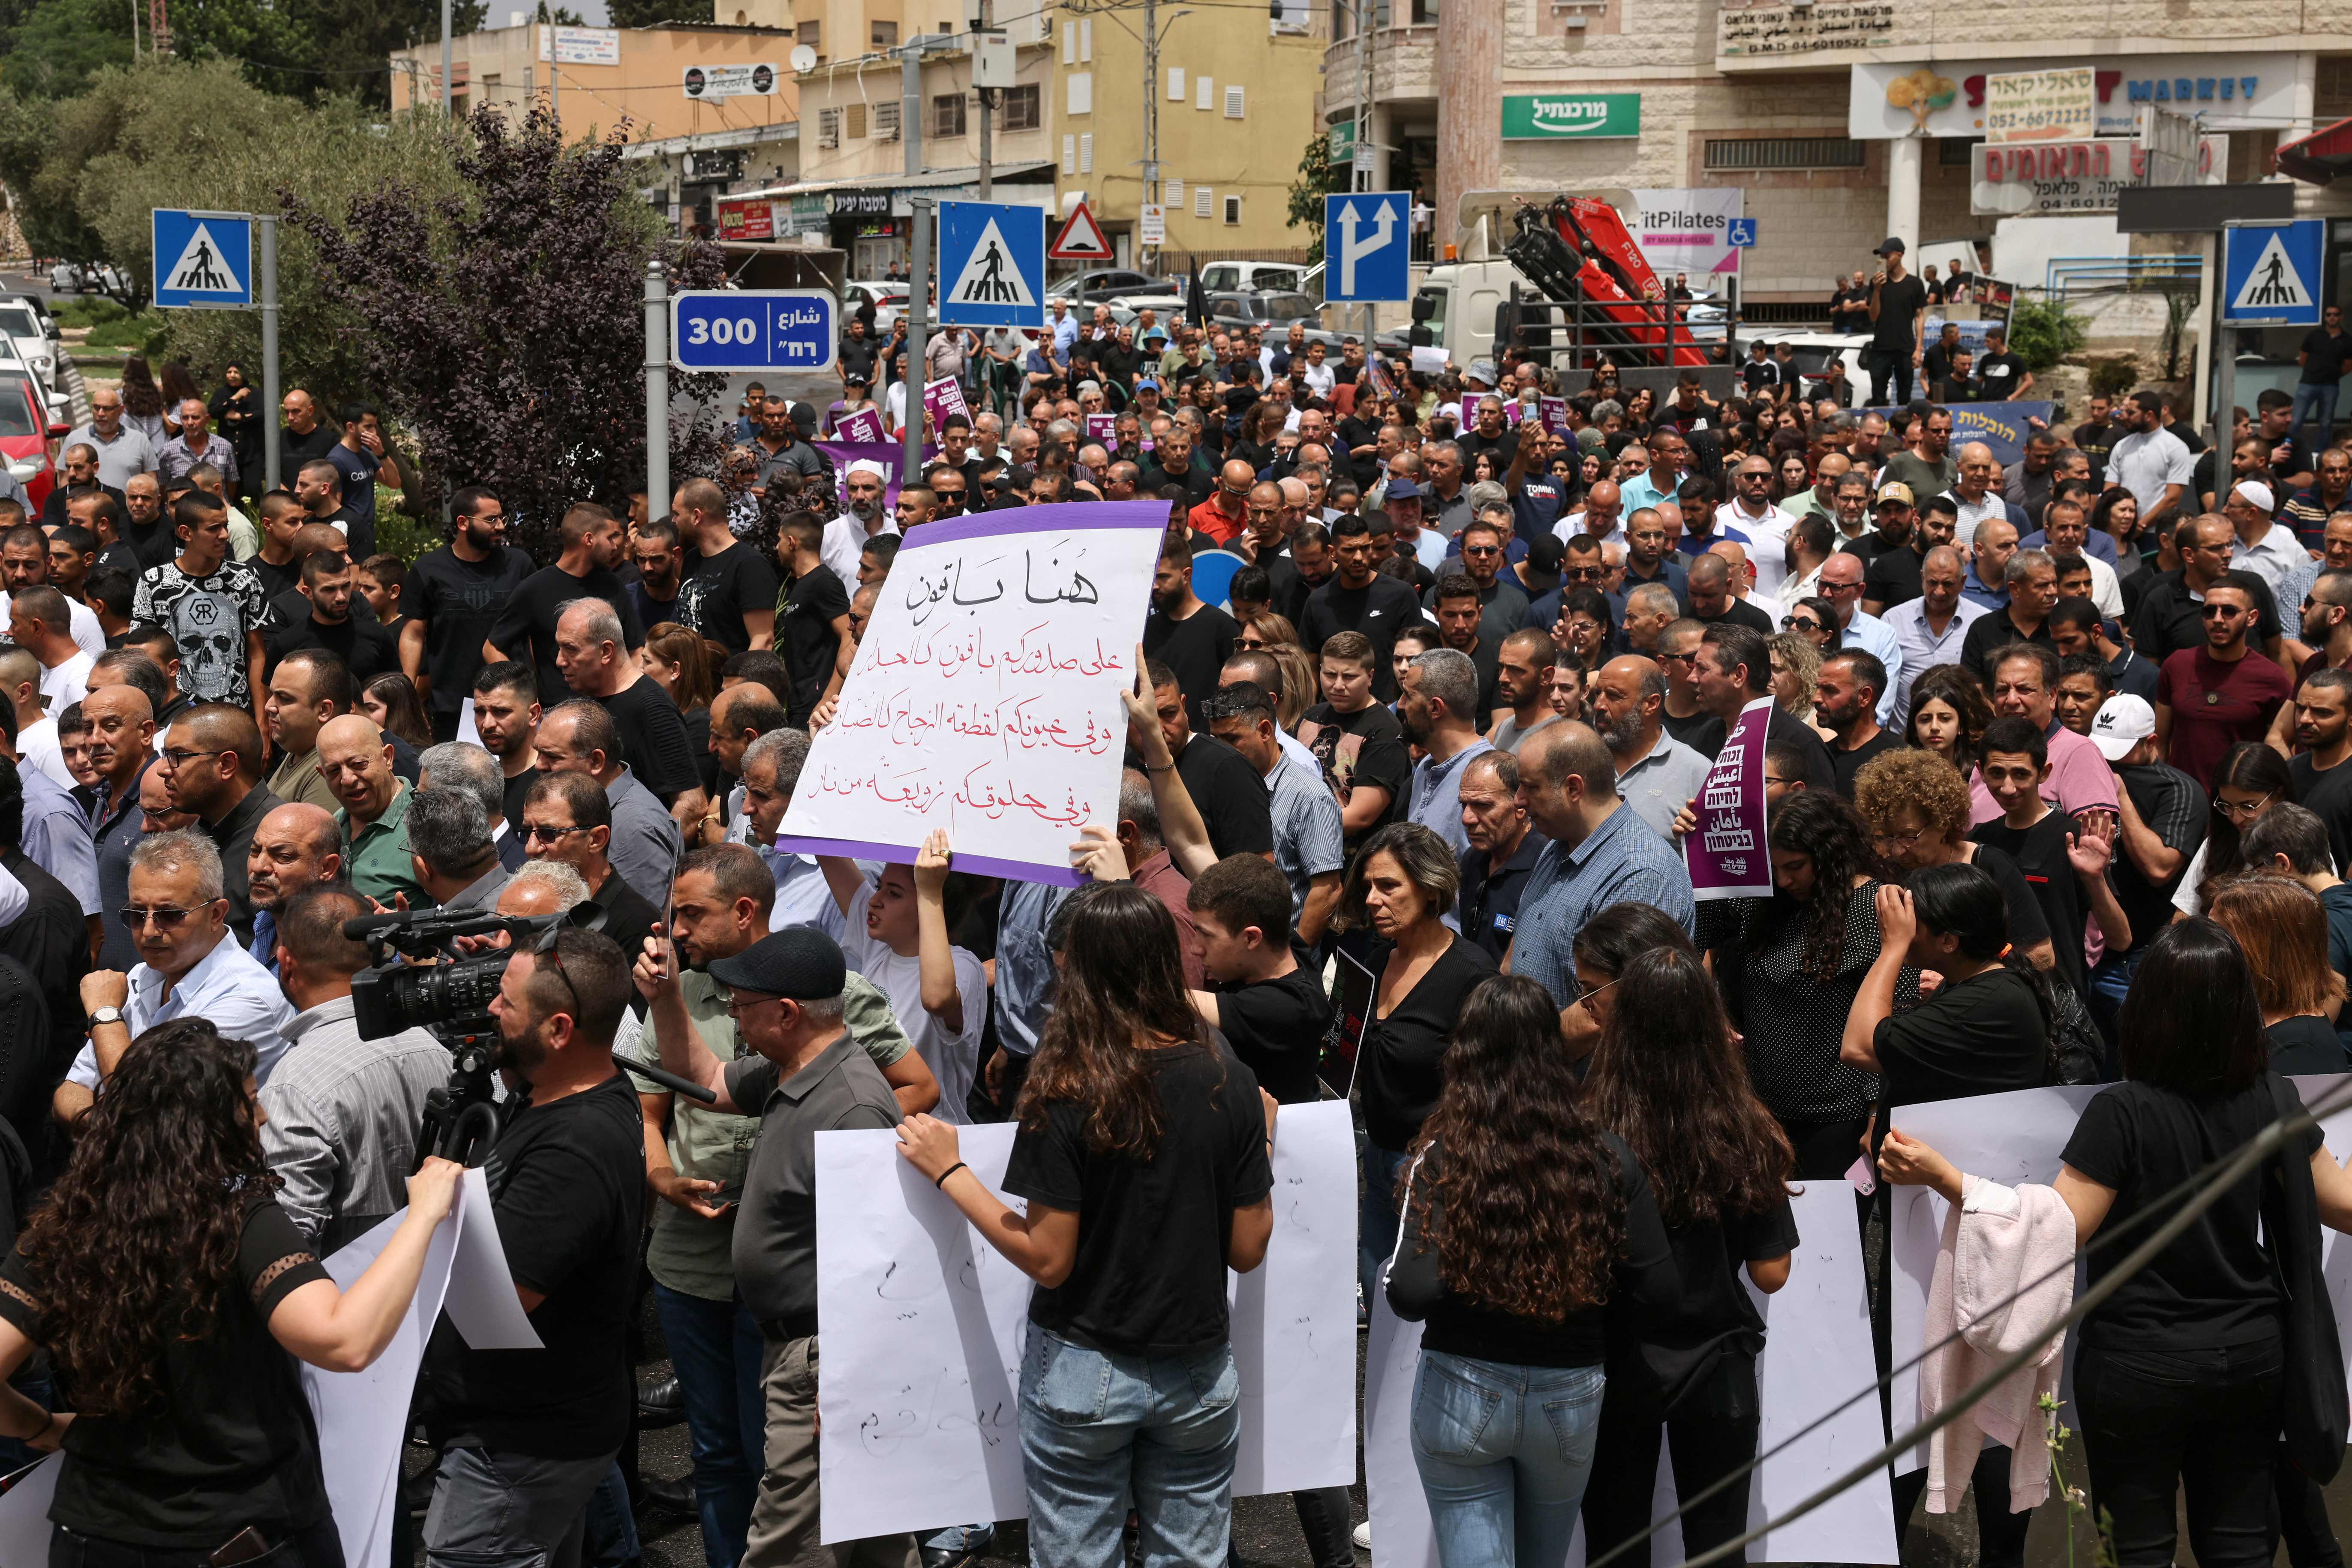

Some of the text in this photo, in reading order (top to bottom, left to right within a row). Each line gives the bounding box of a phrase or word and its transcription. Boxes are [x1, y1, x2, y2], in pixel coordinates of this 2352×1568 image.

[1989, 73, 2092, 96] סאליקאר
[2127, 76, 2258, 101] MARKET
[1532, 98, 1607, 119] מרכנתיל
[1989, 108, 2092, 128] 052-6672222
[1985, 143, 2111, 182] התאומים
[2034, 180, 2080, 197] פלאפל
[835, 195, 887, 213] מטבח יפיע
[1621, 241, 1642, 268] F120
[688, 318, 757, 345] 300
[778, 307, 820, 330] شارع
[940, 393, 958, 403] ביחד
[1957, 410, 2016, 443] הובלות
[939, 626, 994, 678] باقون
[998, 620, 1078, 693] صدوركم
[1080, 637, 1123, 676] على
[892, 698, 944, 745] الزجاج
[947, 693, 1018, 739] كقطعة
[1003, 693, 1067, 761] عيونكم
[1050, 710, 1112, 755] وفي
[1718, 750, 1741, 764] זכותי
[808, 763, 836, 799] نار
[838, 778, 862, 795] من
[1707, 759, 1743, 789] أعيش
[951, 759, 1047, 838] حلوقكم
[1030, 787, 1091, 827] وفي
[1707, 788, 1739, 806] לחיות
[1710, 806, 1742, 834] بأمان
[1707, 832, 1752, 851] בביטחון
[1496, 916, 1506, 925] GM
